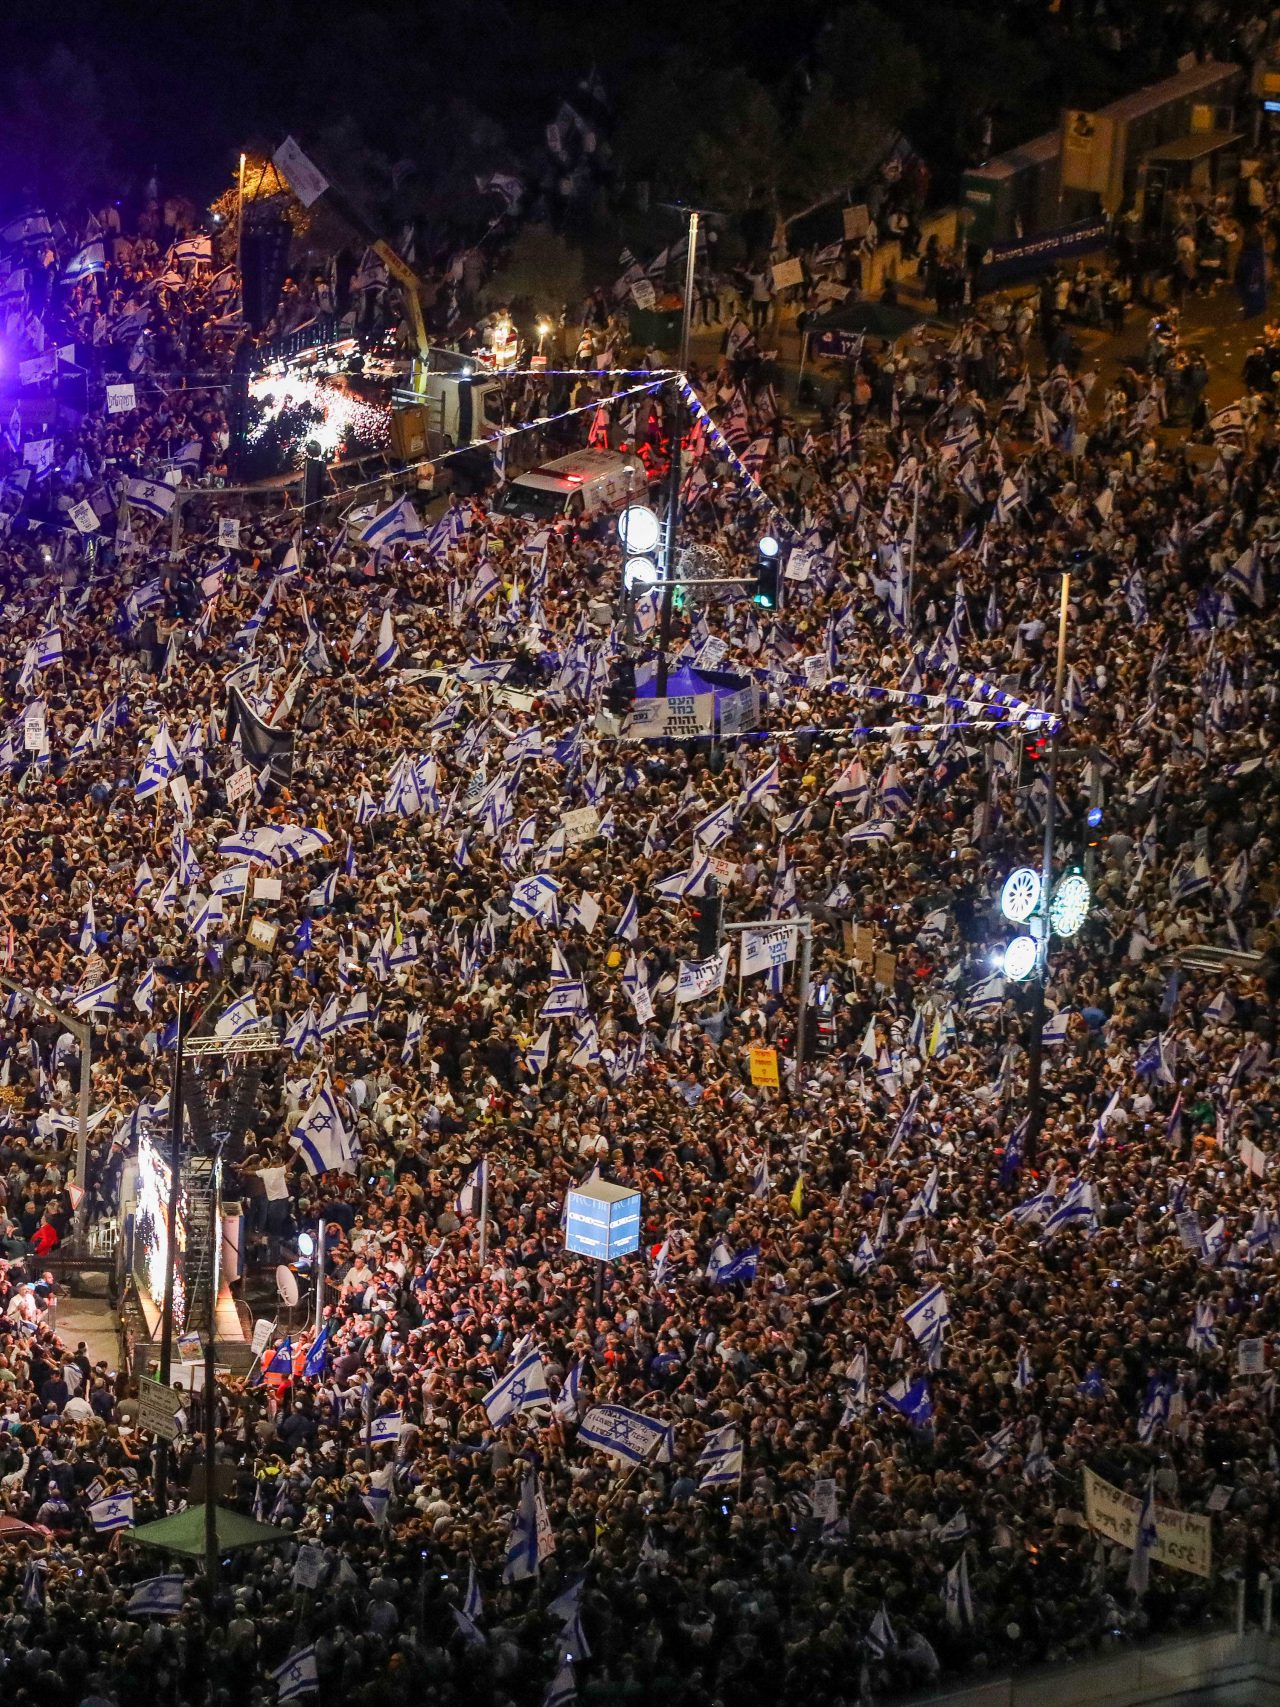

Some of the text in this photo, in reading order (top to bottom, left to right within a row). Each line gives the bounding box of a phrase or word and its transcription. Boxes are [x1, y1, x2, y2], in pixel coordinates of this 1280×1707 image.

[668, 696, 695, 704] העם
[668, 704, 695, 714] בחר
[667, 715, 697, 725] זהות
[662, 725, 704, 735] יהודית
